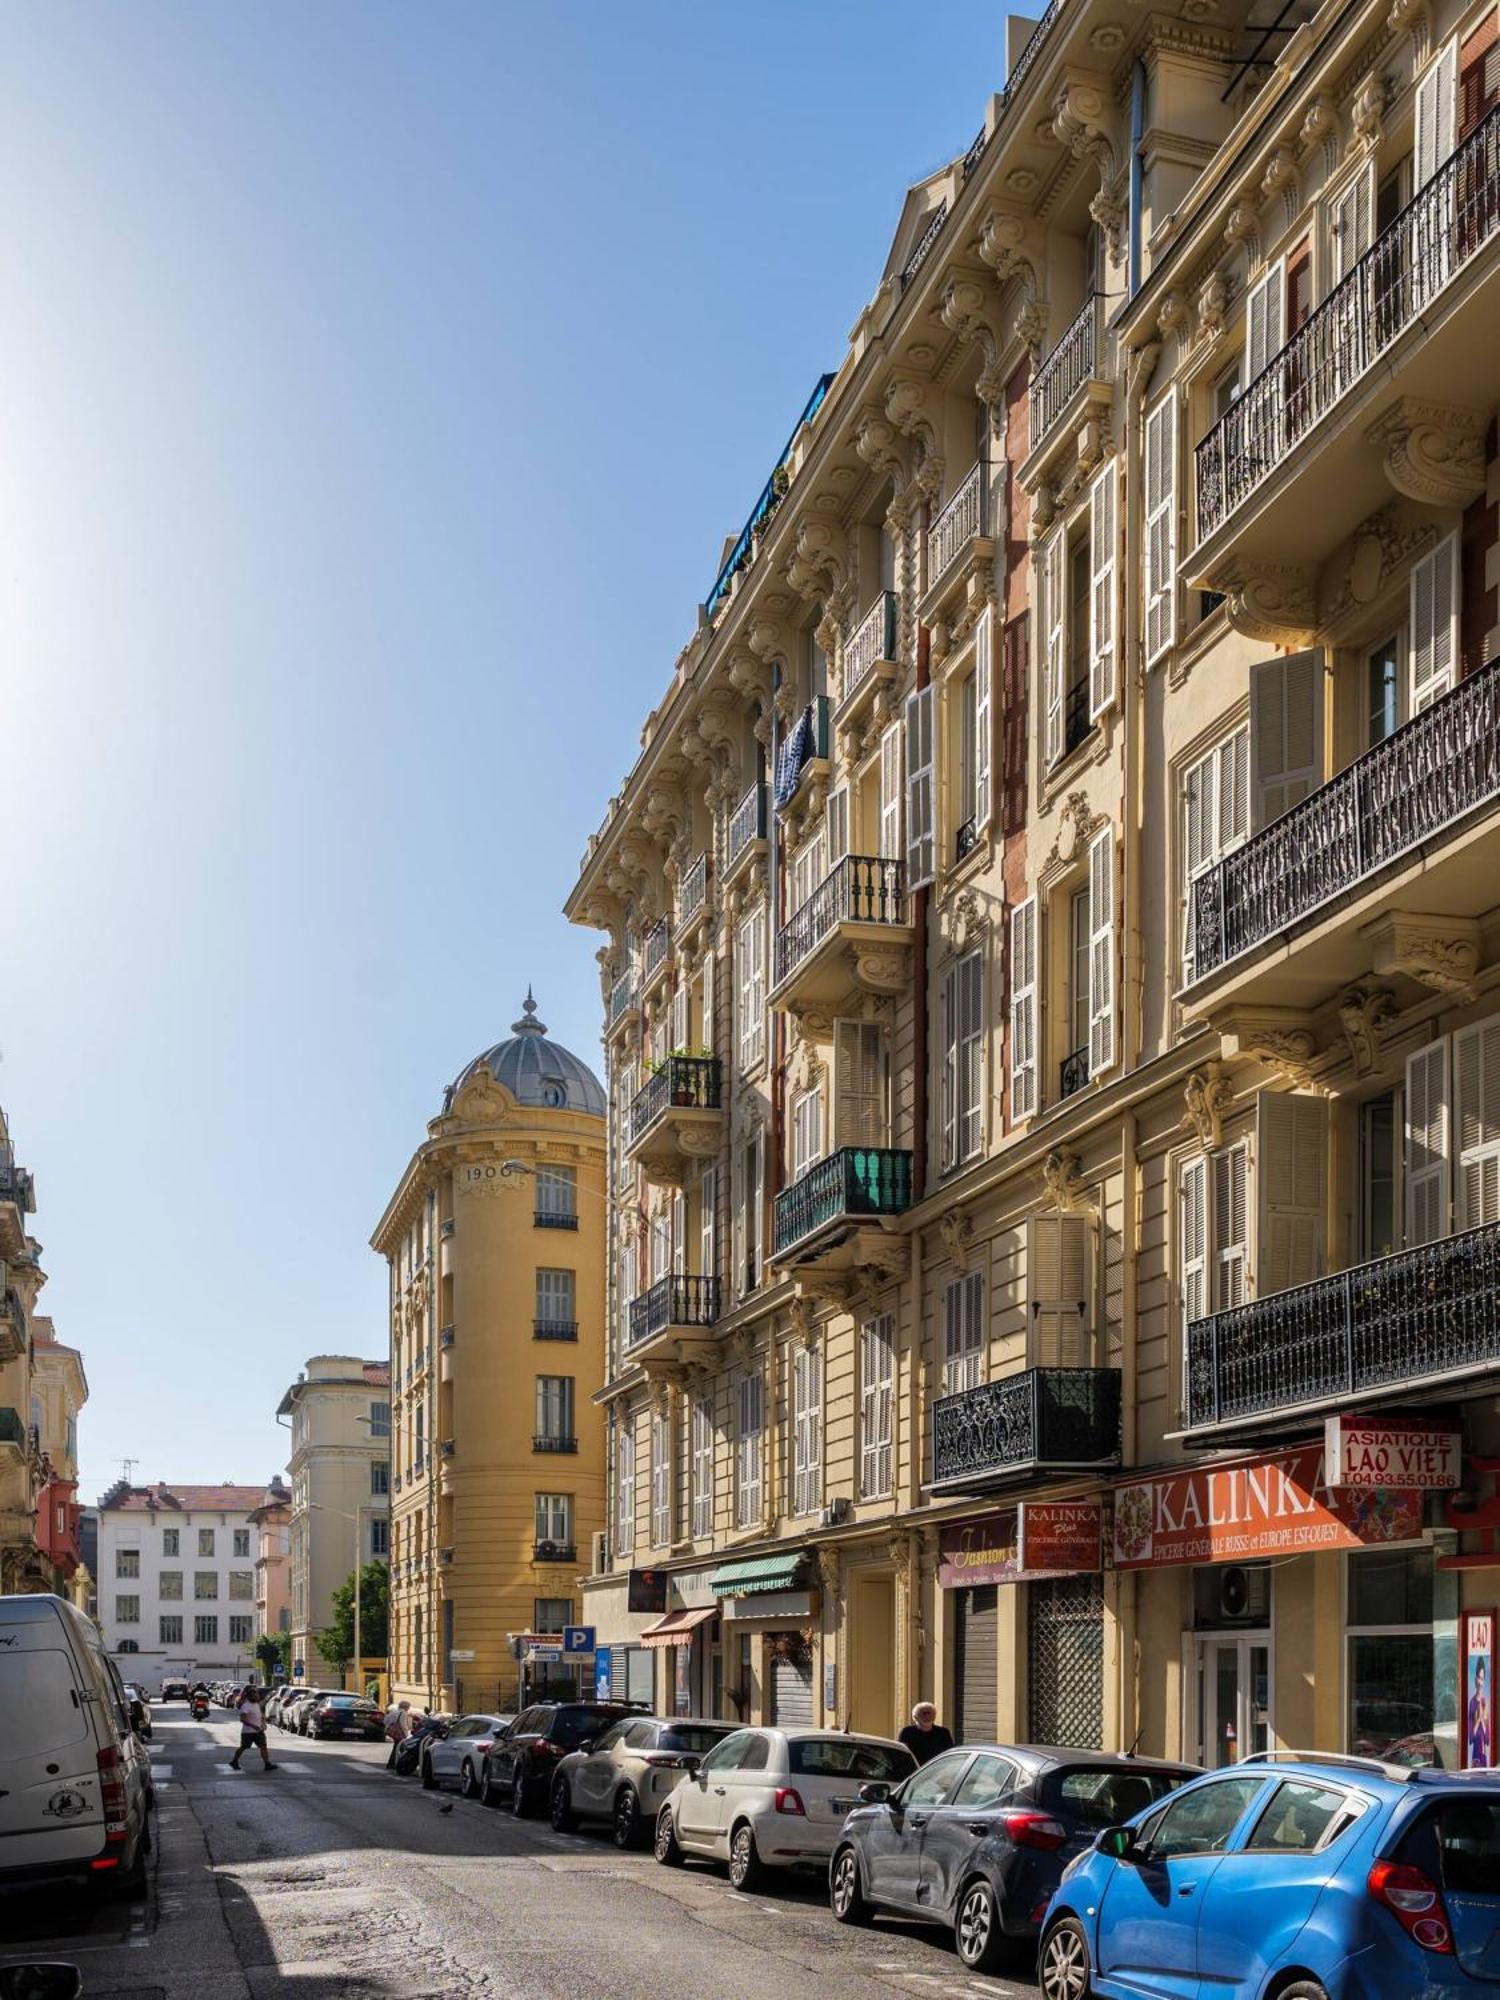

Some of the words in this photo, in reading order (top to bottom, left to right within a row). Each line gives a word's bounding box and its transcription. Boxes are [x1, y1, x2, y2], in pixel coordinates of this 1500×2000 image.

[1346, 1433, 1451, 1447] ASIATIQUE
[1346, 1448, 1389, 1472] LAO
[1399, 1448, 1452, 1473] VIET
[1153, 1453, 1339, 1534] KALINKA
[1028, 1508, 1098, 1521] KALINKA
[1052, 1523, 1078, 1537] Plus
[1226, 1533, 1250, 1553] RUSSE
[1250, 1536, 1259, 1549] et
[1260, 1528, 1293, 1549] EUROPE
[572, 1631, 586, 1649] P
[1471, 1621, 1488, 1649] LAO
